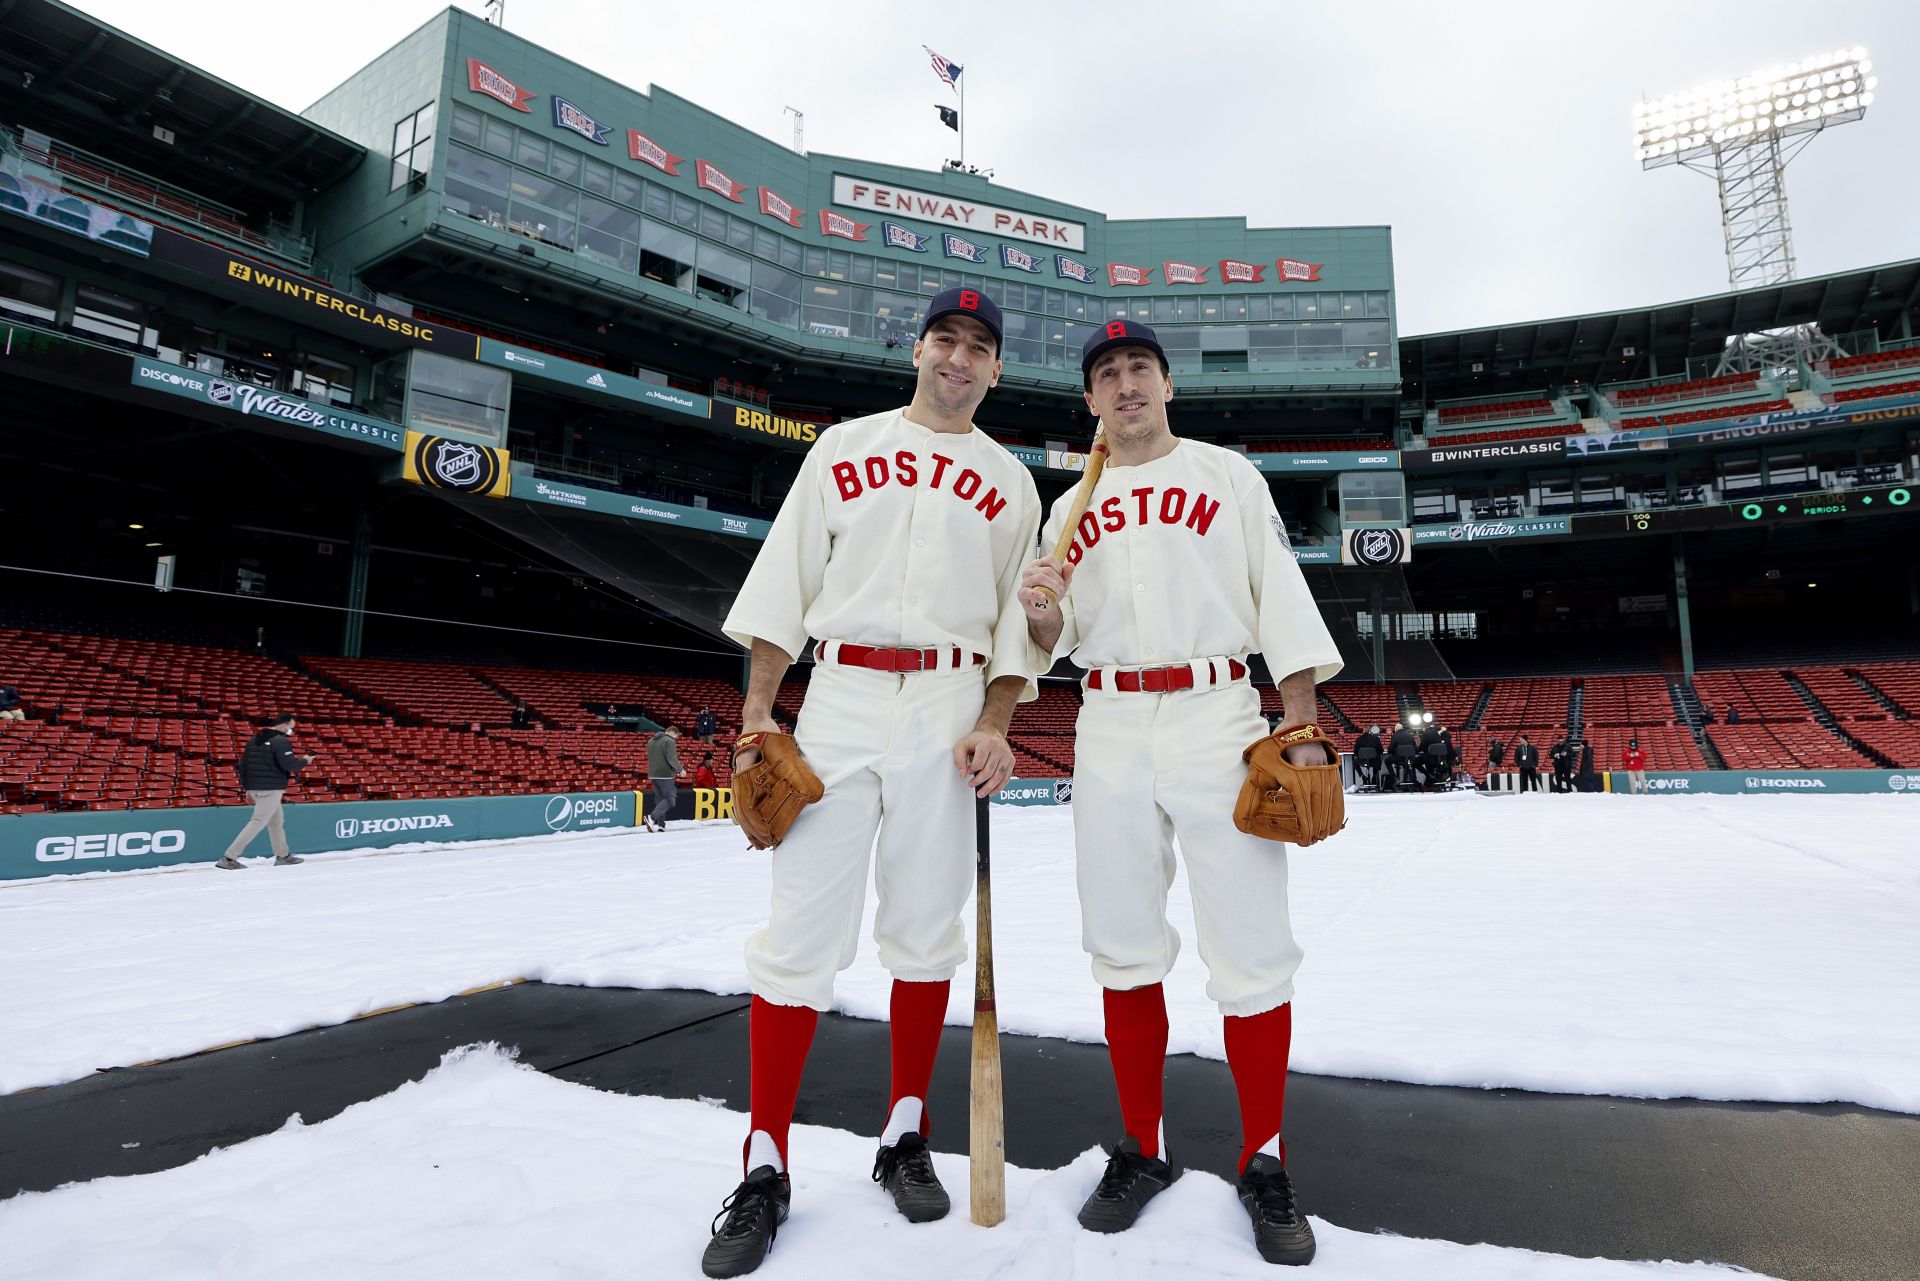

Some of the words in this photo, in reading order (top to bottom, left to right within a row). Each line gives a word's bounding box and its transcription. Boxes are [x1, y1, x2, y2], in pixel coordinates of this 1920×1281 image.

[853, 184, 975, 223] FENWAY
[995, 213, 1068, 242] PARK
[228, 260, 433, 341] #WINTERCLASSIC
[959, 290, 980, 310] B
[1106, 321, 1127, 339] B
[140, 367, 204, 392] DISCOVER
[236, 384, 325, 427] Winter
[328, 417, 399, 442] CLASSIC
[654, 391, 693, 407] MassMutual
[735, 406, 817, 442] BRUINS
[1358, 456, 1387, 464] GEICO
[1432, 442, 1562, 462] #WINTERCLASSIC
[446, 455, 473, 474] NHL
[832, 450, 1007, 522] BOSTON
[631, 505, 680, 520] ticketmaster
[1803, 505, 1839, 515] PERIOD
[722, 518, 748, 529] TRULY
[1416, 530, 1447, 539] DISCOVER
[1463, 522, 1516, 541] Winter
[1518, 521, 1565, 531] CLASSIC
[1301, 551, 1329, 559] FANDUEL
[1369, 538, 1386, 555] NHL
[1761, 778, 1826, 788] HONDA
[1000, 788, 1050, 801] DISCOVER
[574, 795, 617, 818] pepsi
[360, 814, 454, 835] HONDA
[579, 818, 593, 826] ZERO
[594, 817, 611, 825] SUGAR
[35, 829, 185, 862] GEICO
